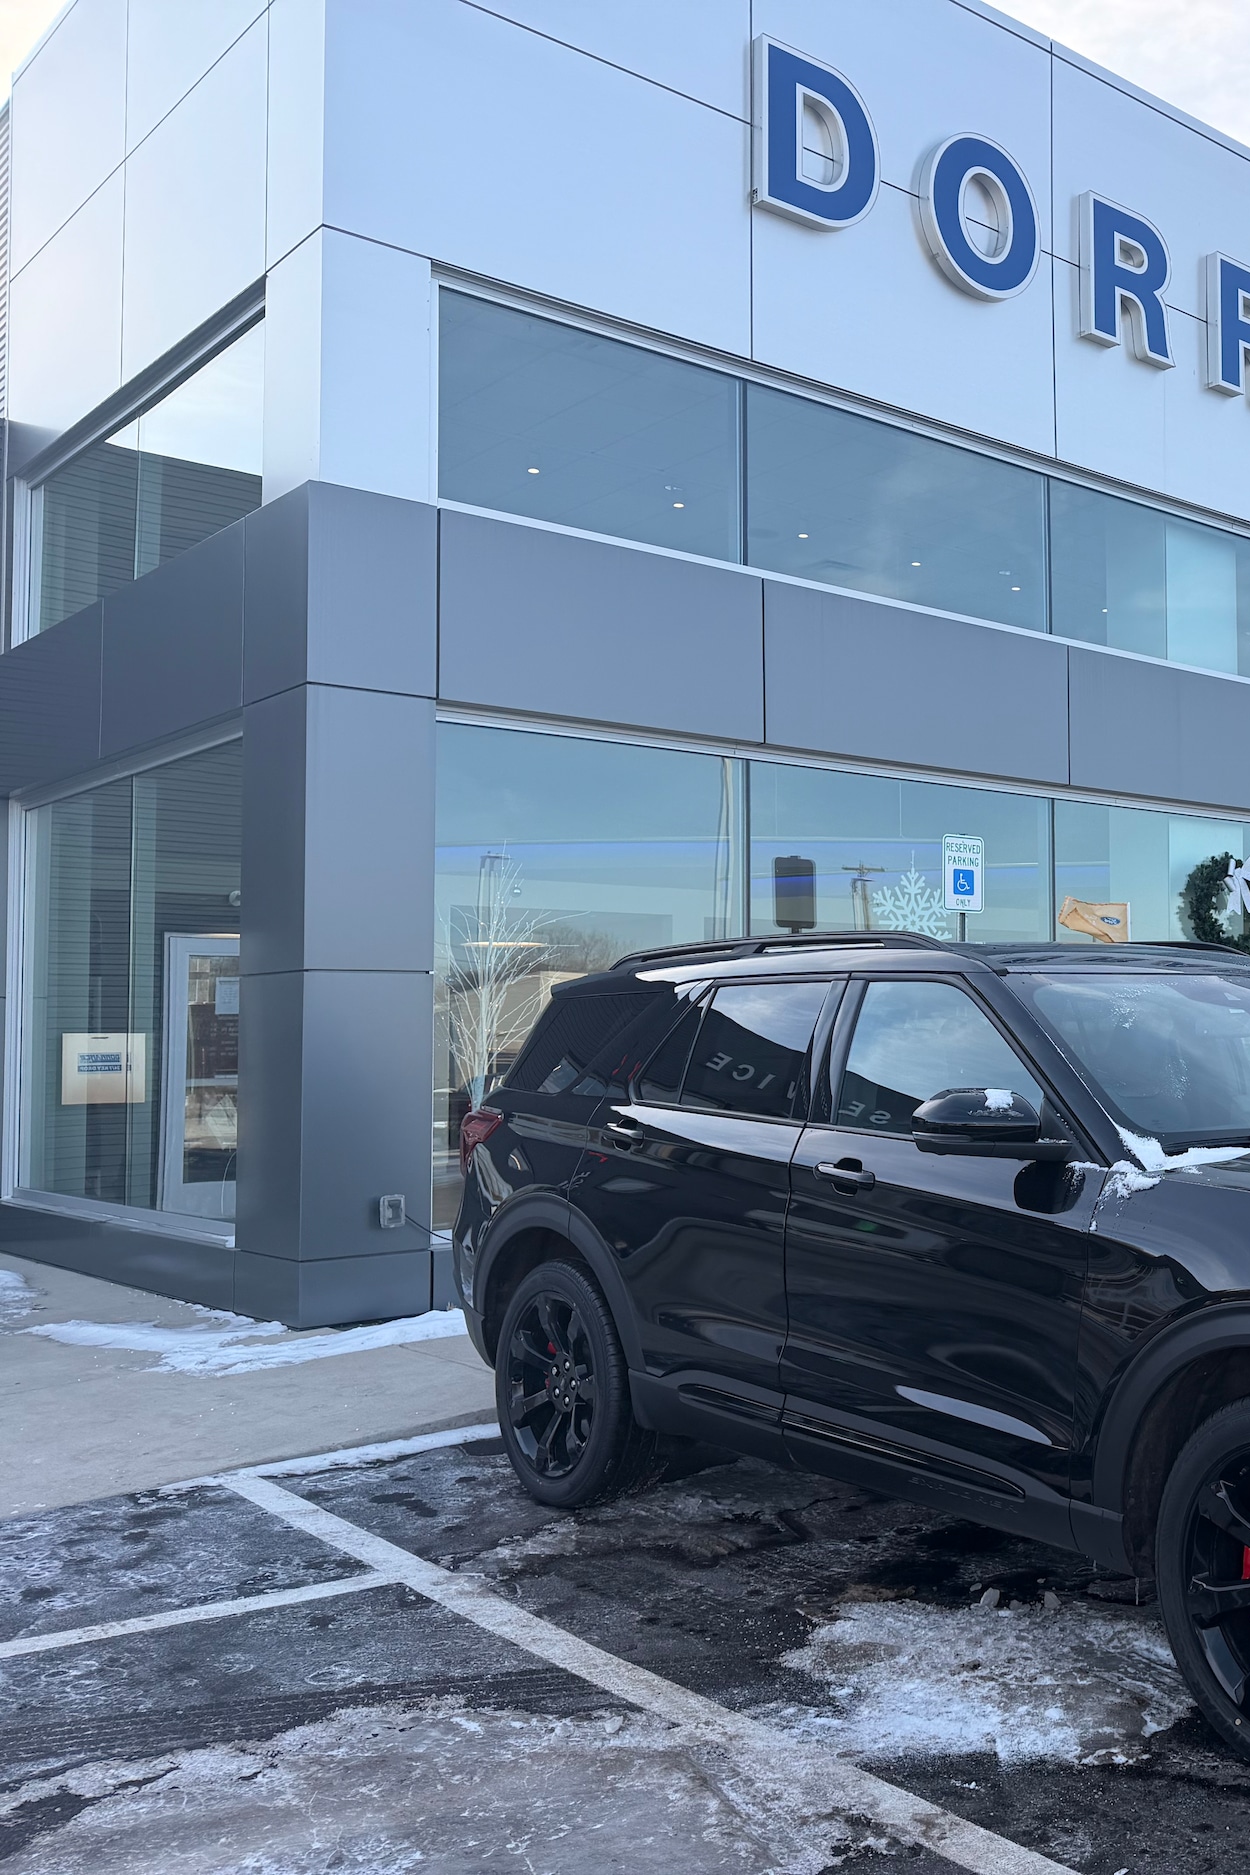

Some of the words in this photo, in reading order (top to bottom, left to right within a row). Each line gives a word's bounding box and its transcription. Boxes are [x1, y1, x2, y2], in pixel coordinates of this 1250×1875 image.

[946, 841, 981, 855] RESERVED
[947, 855, 980, 868] PARKING
[955, 897, 971, 908] ONLY
